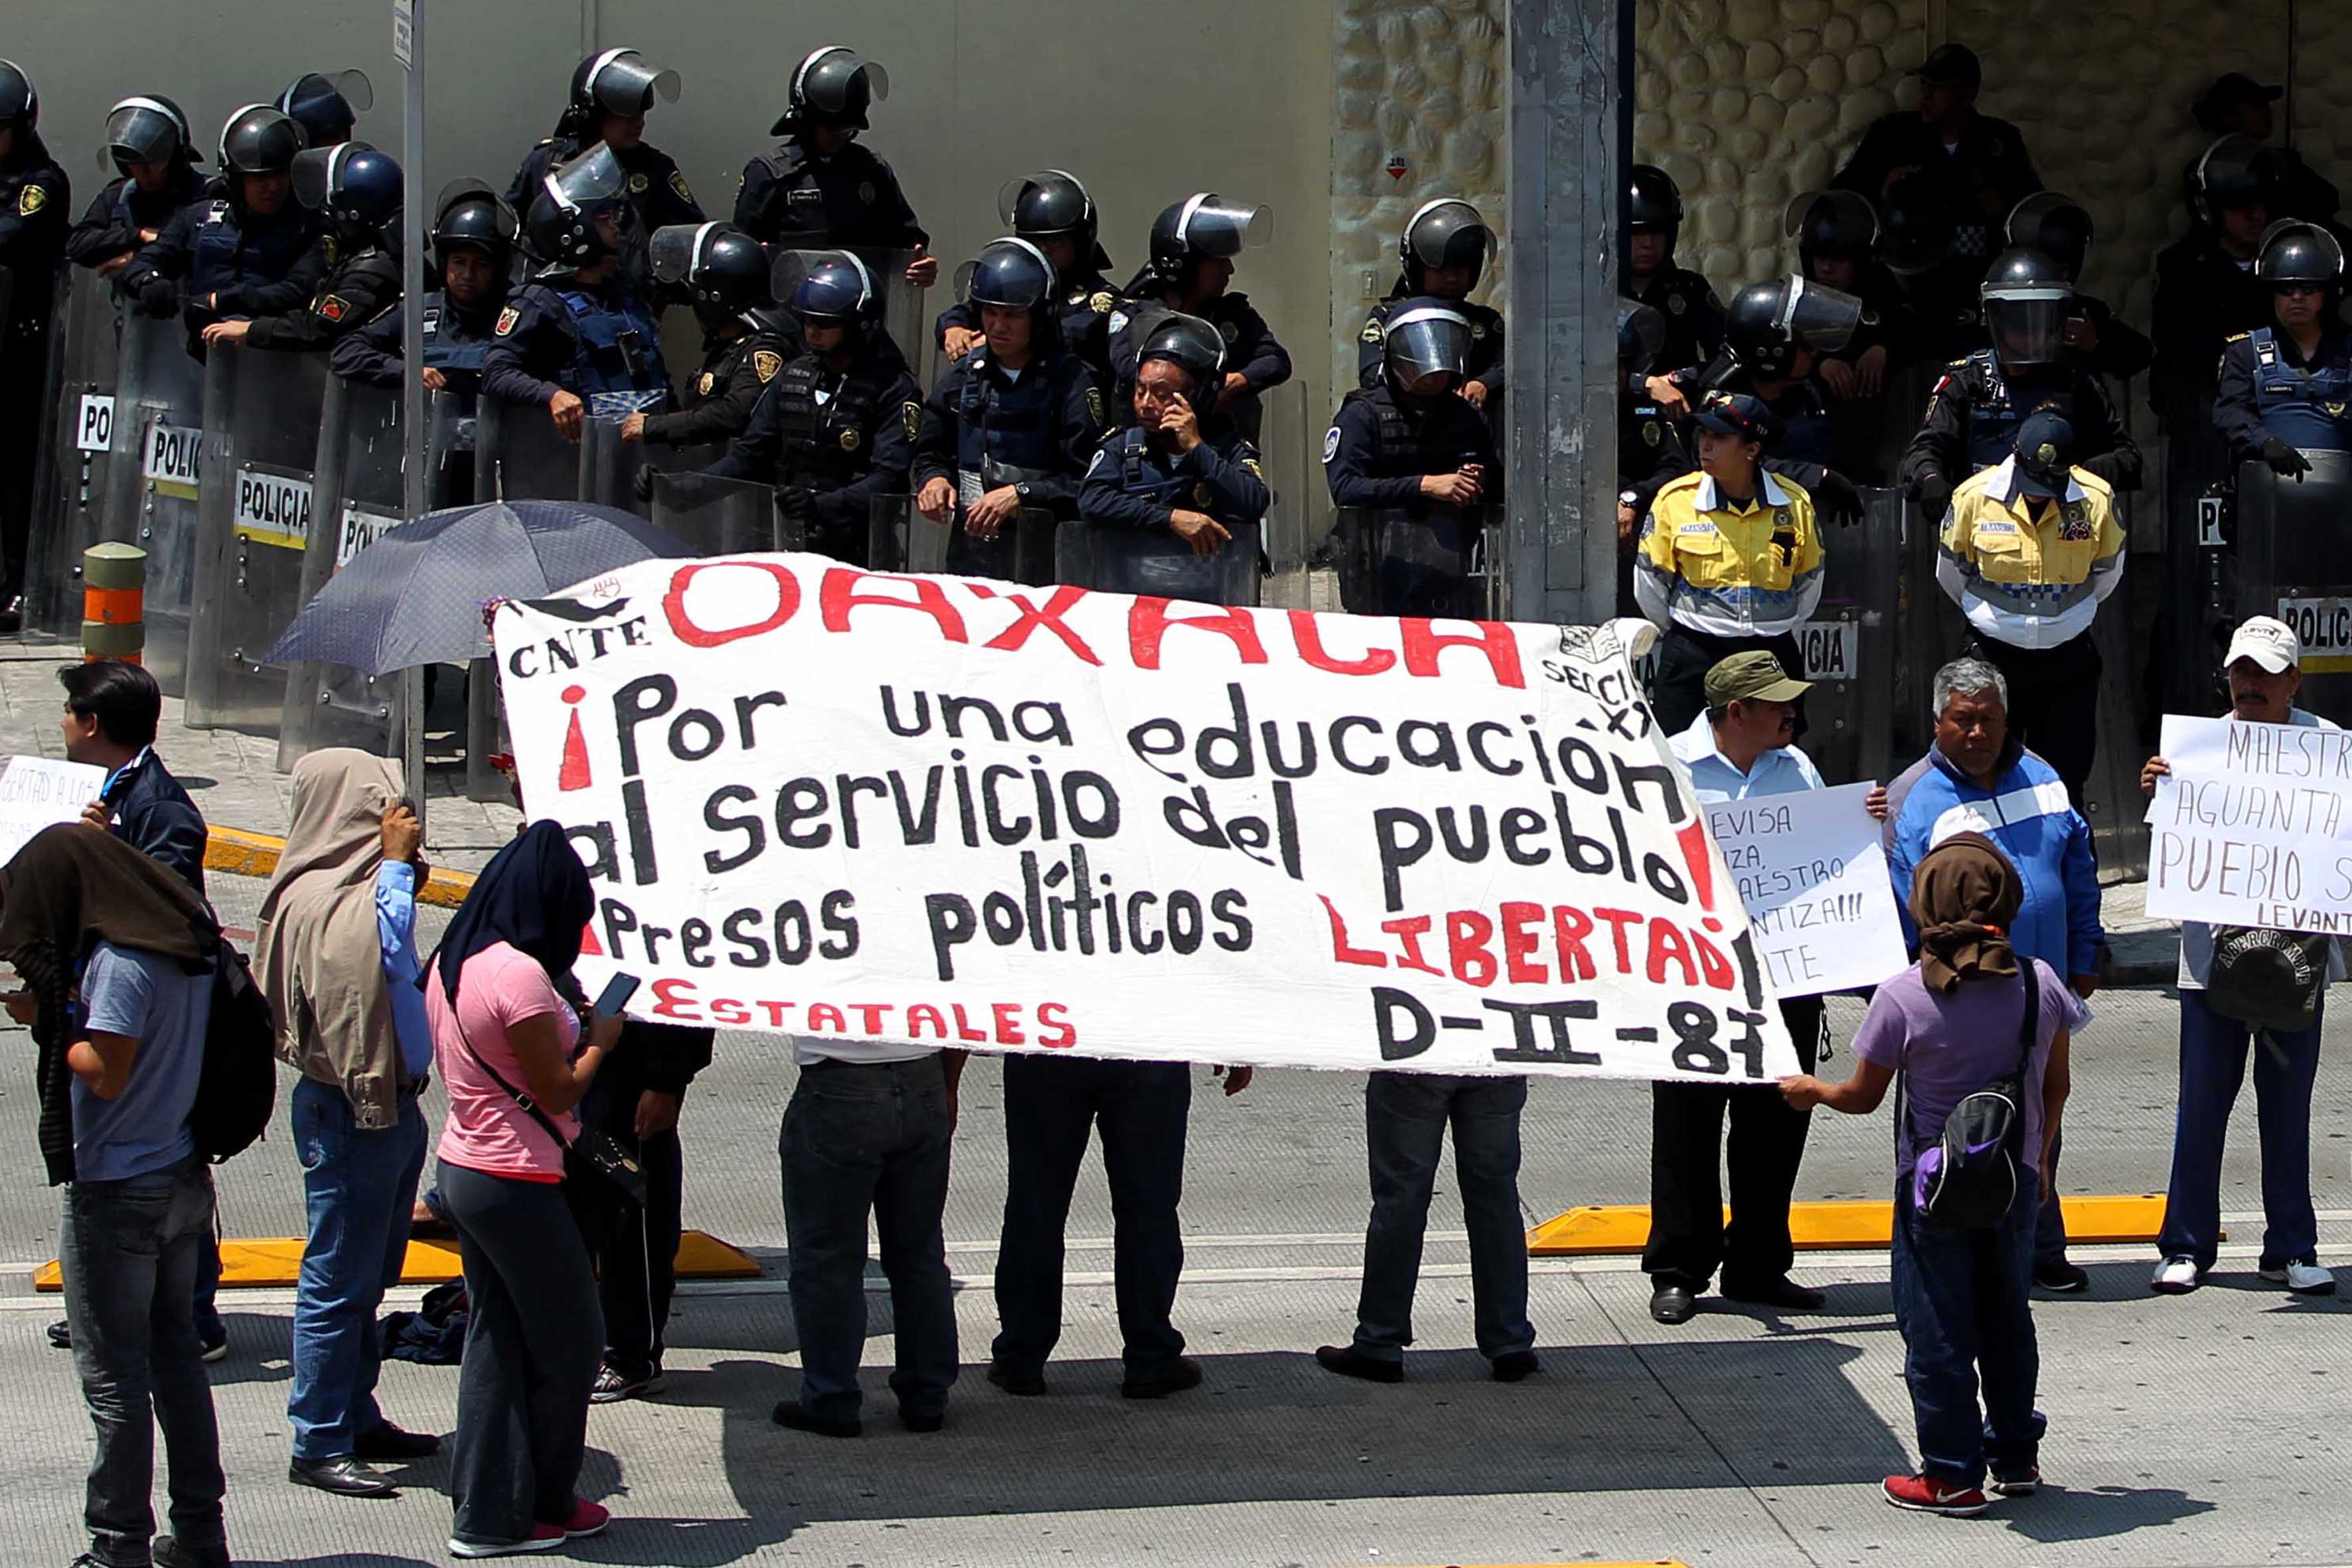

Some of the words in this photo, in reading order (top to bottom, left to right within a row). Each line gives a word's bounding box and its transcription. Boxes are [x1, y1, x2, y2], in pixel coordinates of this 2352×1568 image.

[240, 480, 311, 528] POLICIA
[509, 615, 653, 679] CNTE
[663, 560, 1526, 689] OAXACA
[880, 684, 1073, 746] una
[1127, 682, 1684, 824] educación
[565, 779, 659, 886] al
[703, 749, 1121, 876] servicio
[1162, 781, 1304, 881] del
[1373, 790, 1723, 933] pueblo!
[2174, 779, 2341, 838] AGUANTA
[2159, 831, 2301, 902] PUEBLO
[924, 843, 1254, 982] políticos
[2218, 929, 2311, 986] ABERCROMBIE
[650, 978, 1078, 1049] ESTATALES
